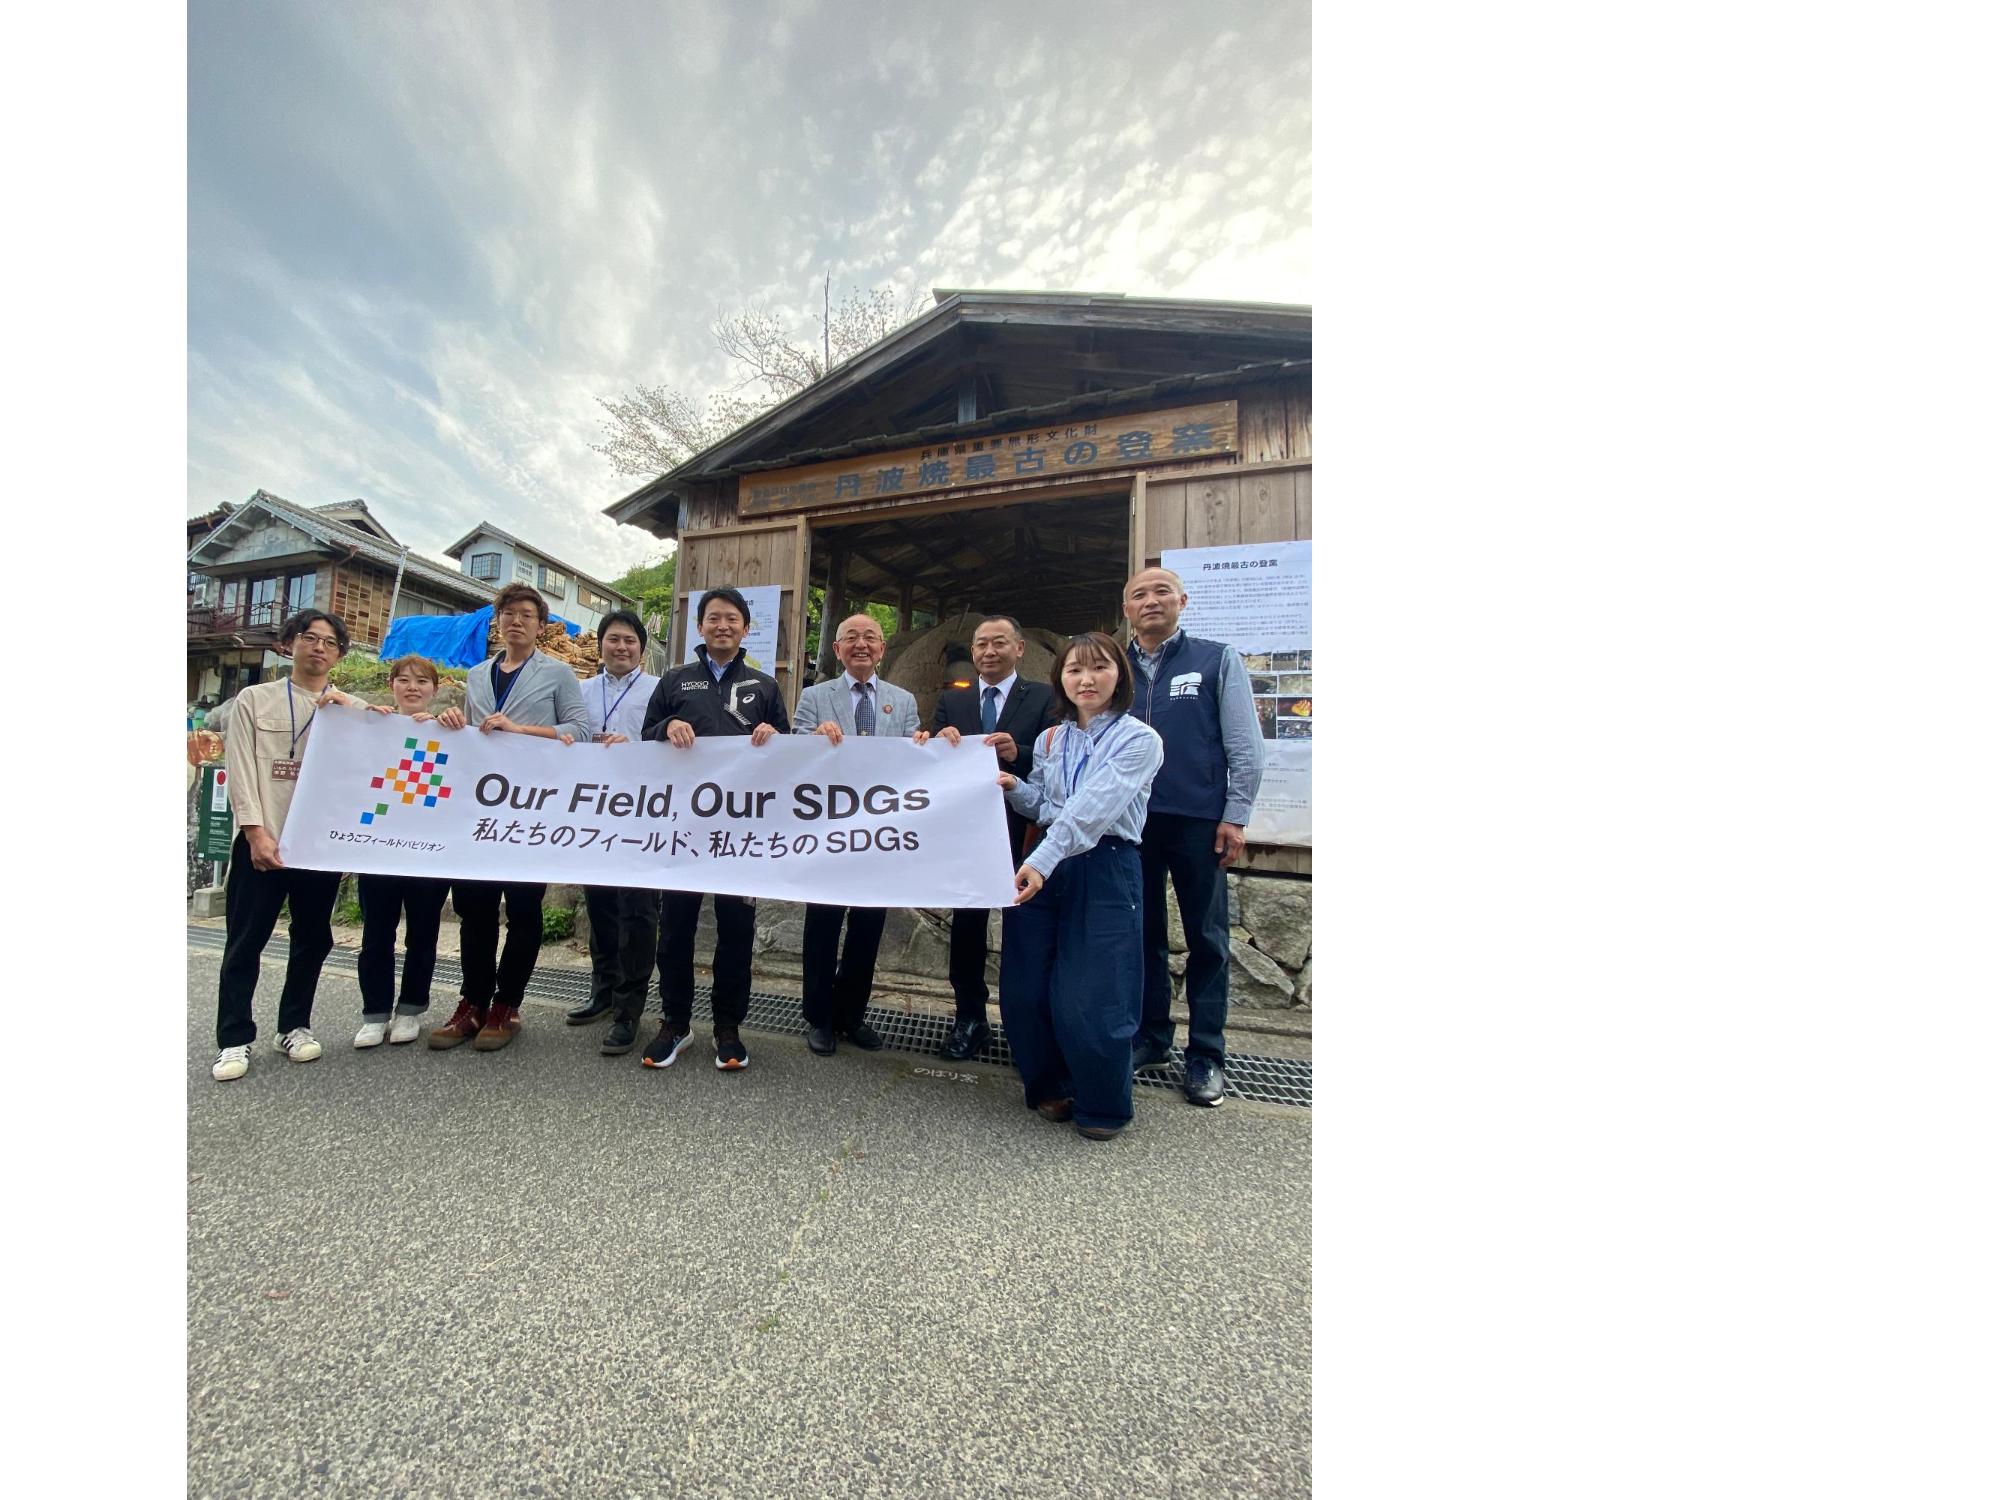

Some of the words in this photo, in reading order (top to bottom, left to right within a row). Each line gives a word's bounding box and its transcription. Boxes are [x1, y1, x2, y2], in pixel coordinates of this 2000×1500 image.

[1202, 558, 1279, 571] 丹波焼最古の登窯
[475, 773, 559, 811] Our
[567, 783, 679, 822] Field,
[690, 781, 777, 819] Our
[792, 783, 931, 821] SDGs
